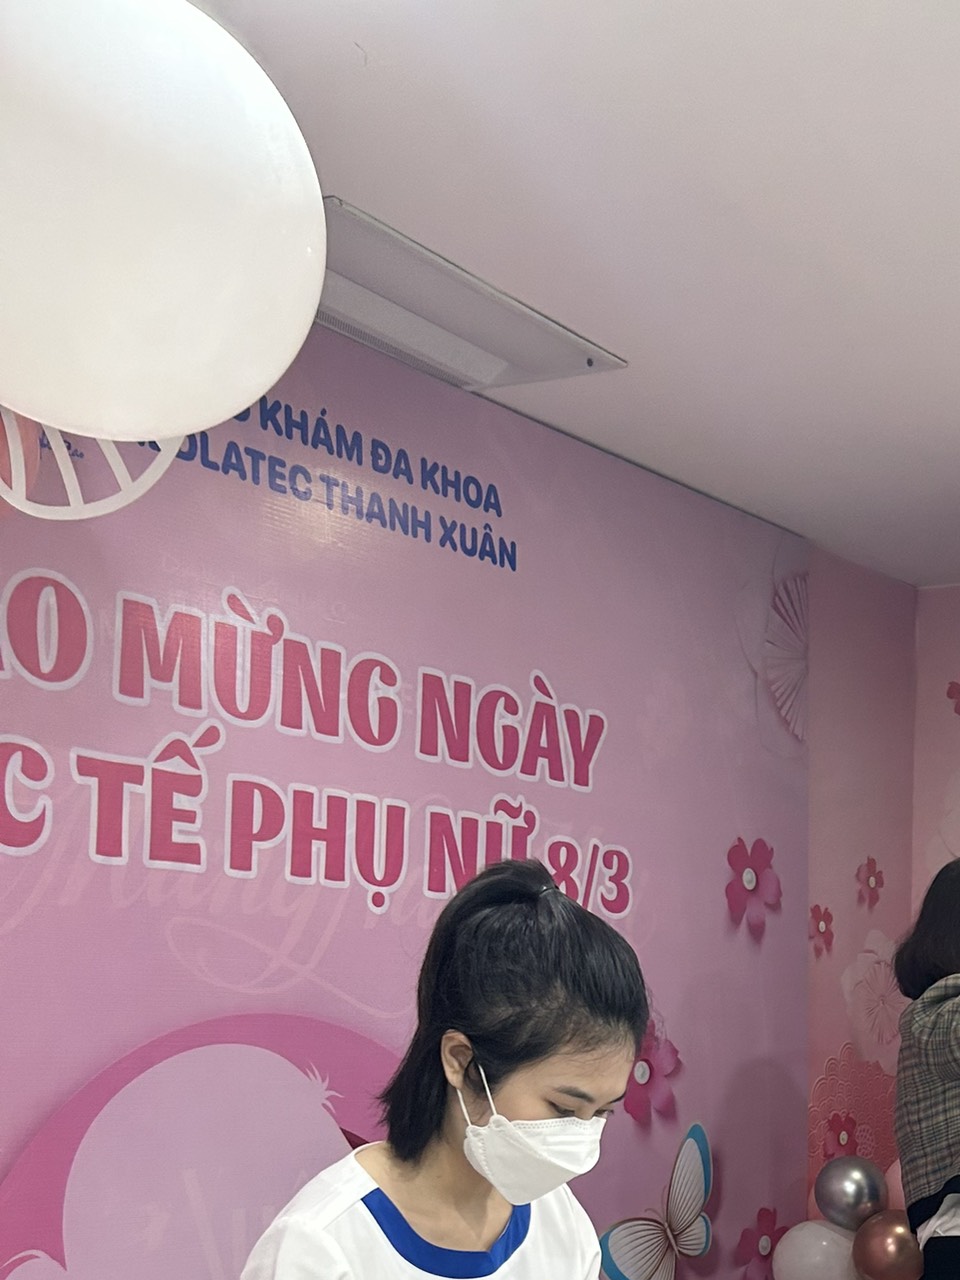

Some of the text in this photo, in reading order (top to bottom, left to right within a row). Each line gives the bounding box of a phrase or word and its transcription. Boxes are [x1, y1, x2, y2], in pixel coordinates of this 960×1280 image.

[259, 394, 364, 468] KHÁM
[369, 444, 415, 485] ĐA
[420, 457, 503, 519] KHOA
[320, 473, 433, 544] THANH
[438, 515, 518, 572] XUÂN
[114, 588, 401, 749] MỪNG
[416, 671, 607, 792] NGÀY
[71, 724, 225, 871] TẾ
[225, 776, 410, 914] PHỤ
[546, 838, 633, 917] 8/3
